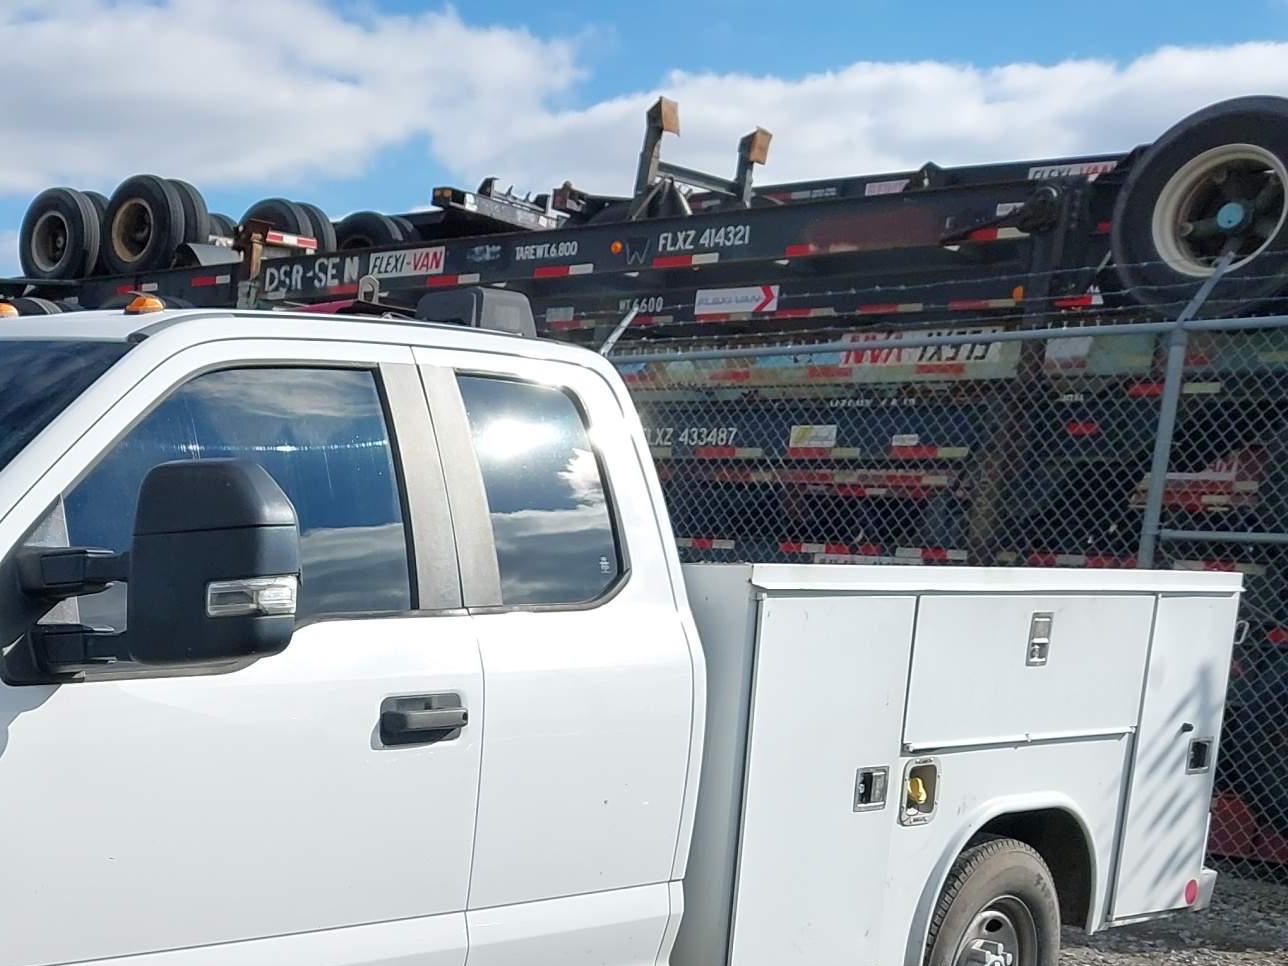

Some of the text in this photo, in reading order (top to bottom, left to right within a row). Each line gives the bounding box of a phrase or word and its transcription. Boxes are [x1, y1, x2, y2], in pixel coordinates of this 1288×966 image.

[659, 225, 750, 252] FLXZ 414321
[370, 252, 442, 274] FLEXI-VAN
[644, 427, 737, 446] LXZ 433487
